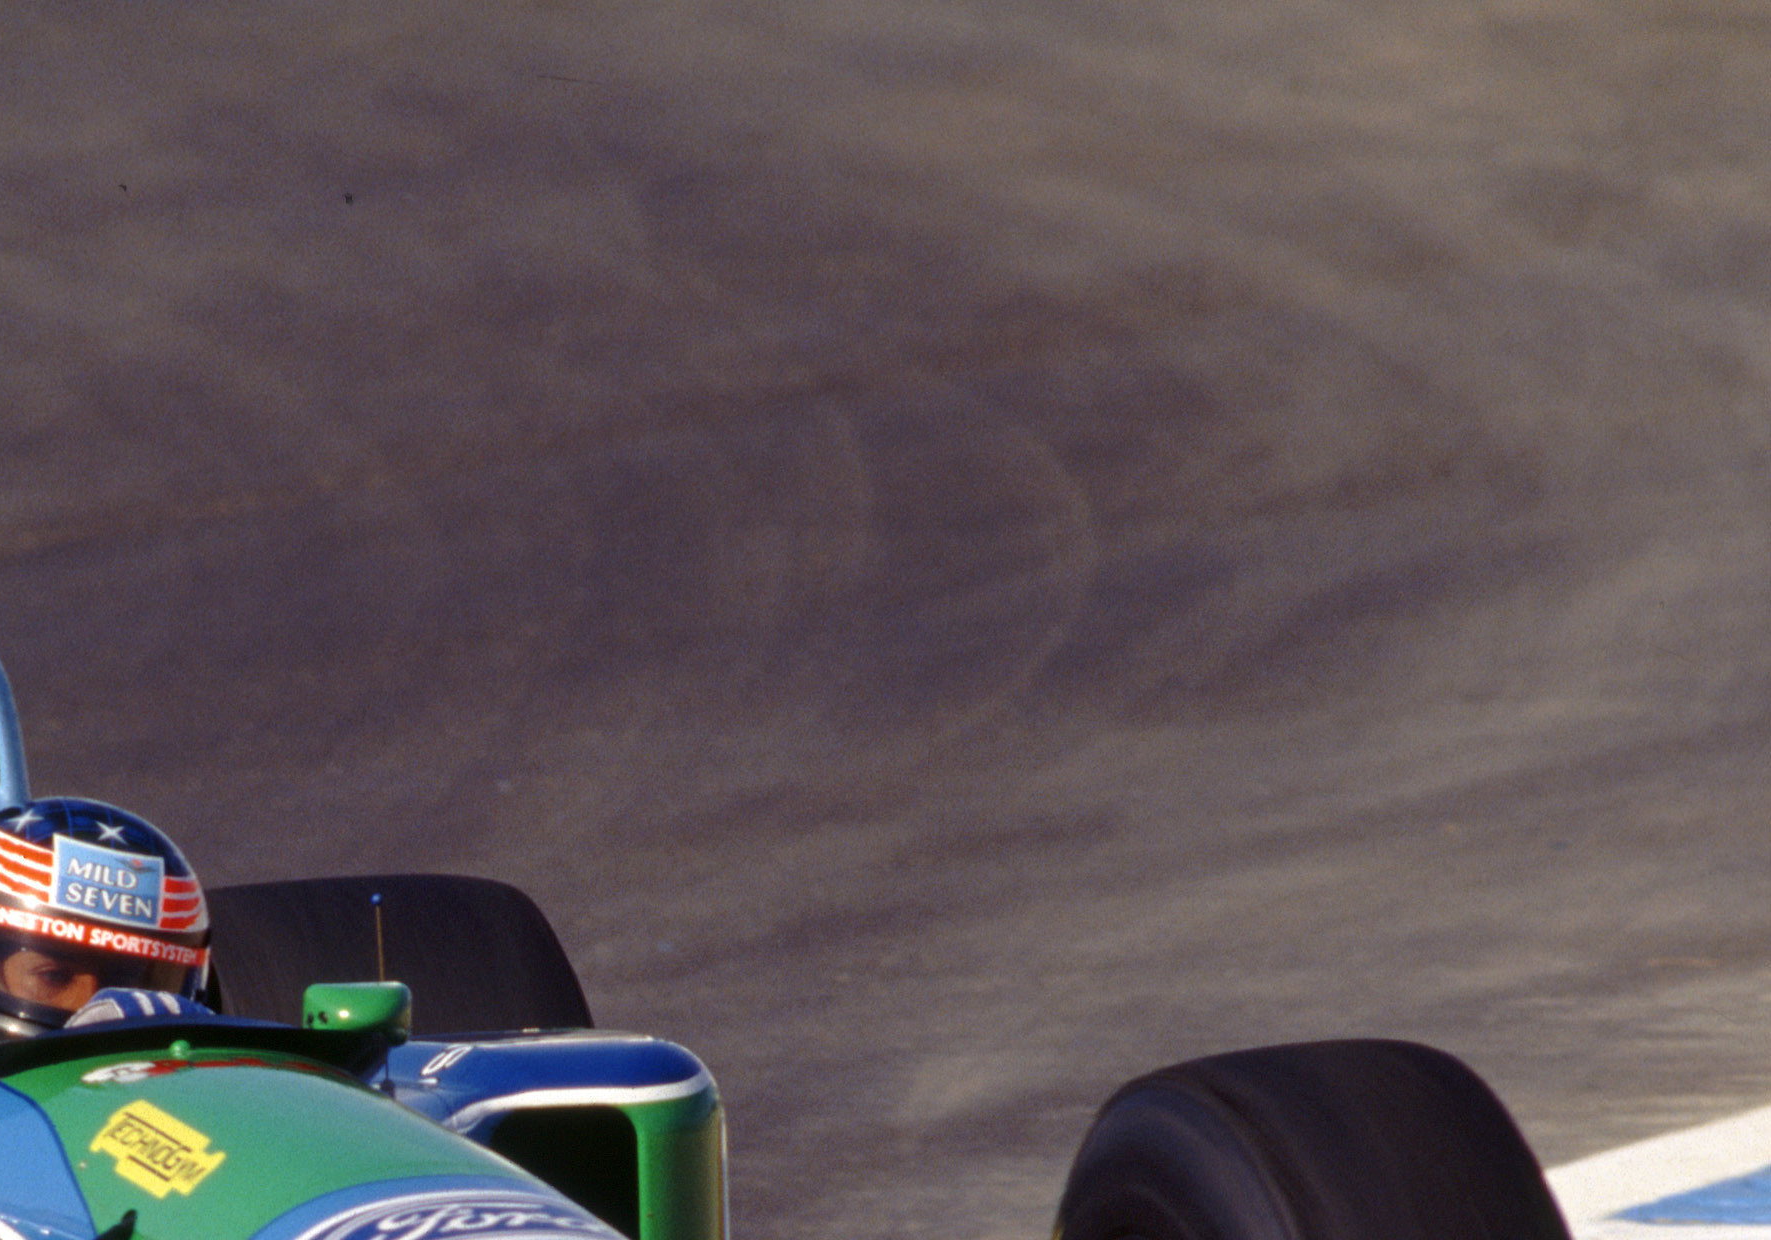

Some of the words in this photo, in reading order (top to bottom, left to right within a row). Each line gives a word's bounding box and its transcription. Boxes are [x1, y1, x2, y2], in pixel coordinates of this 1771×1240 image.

[66, 855, 138, 890] MILD
[65, 882, 153, 918] SEVEN
[89, 926, 200, 965] SPORTSYSTEM
